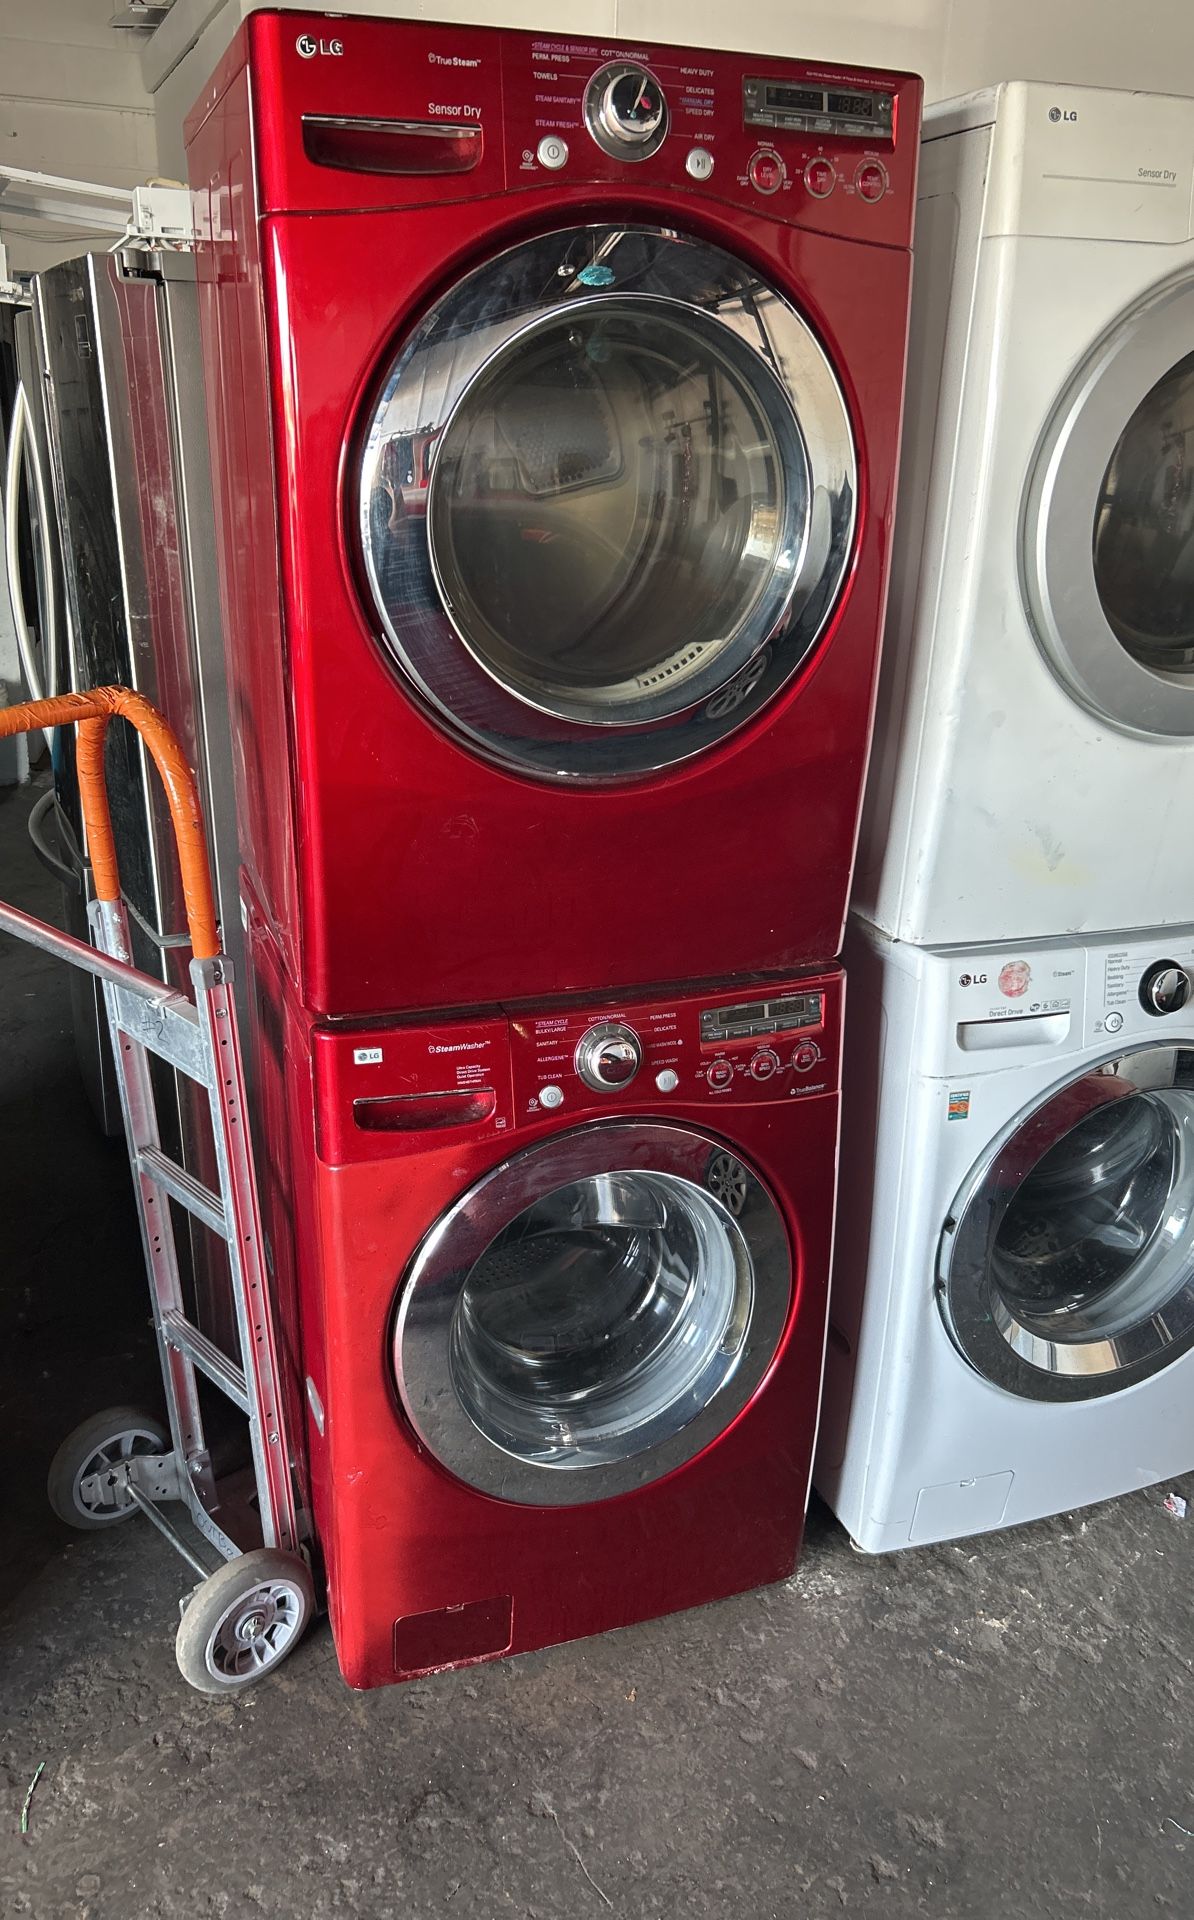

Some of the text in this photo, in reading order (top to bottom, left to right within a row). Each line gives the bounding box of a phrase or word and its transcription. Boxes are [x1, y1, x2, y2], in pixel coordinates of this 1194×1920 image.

[319, 39, 344, 56] LG
[551, 54, 570, 63] PRESS
[533, 71, 558, 81] TOWELS
[680, 67, 714, 77] HEAVY DUTY
[686, 86, 715, 95] DELICATES
[535, 94, 553, 103] STEAM
[428, 102, 482, 120] Sensor Dry
[1063, 110, 1078, 122] LG
[535, 119, 556, 128] STEAM
[703, 133, 715, 141] DRY
[1137, 167, 1177, 182] Sensor Dry
[973, 974, 987, 985] LG
[369, 1052, 380, 1060] LG
